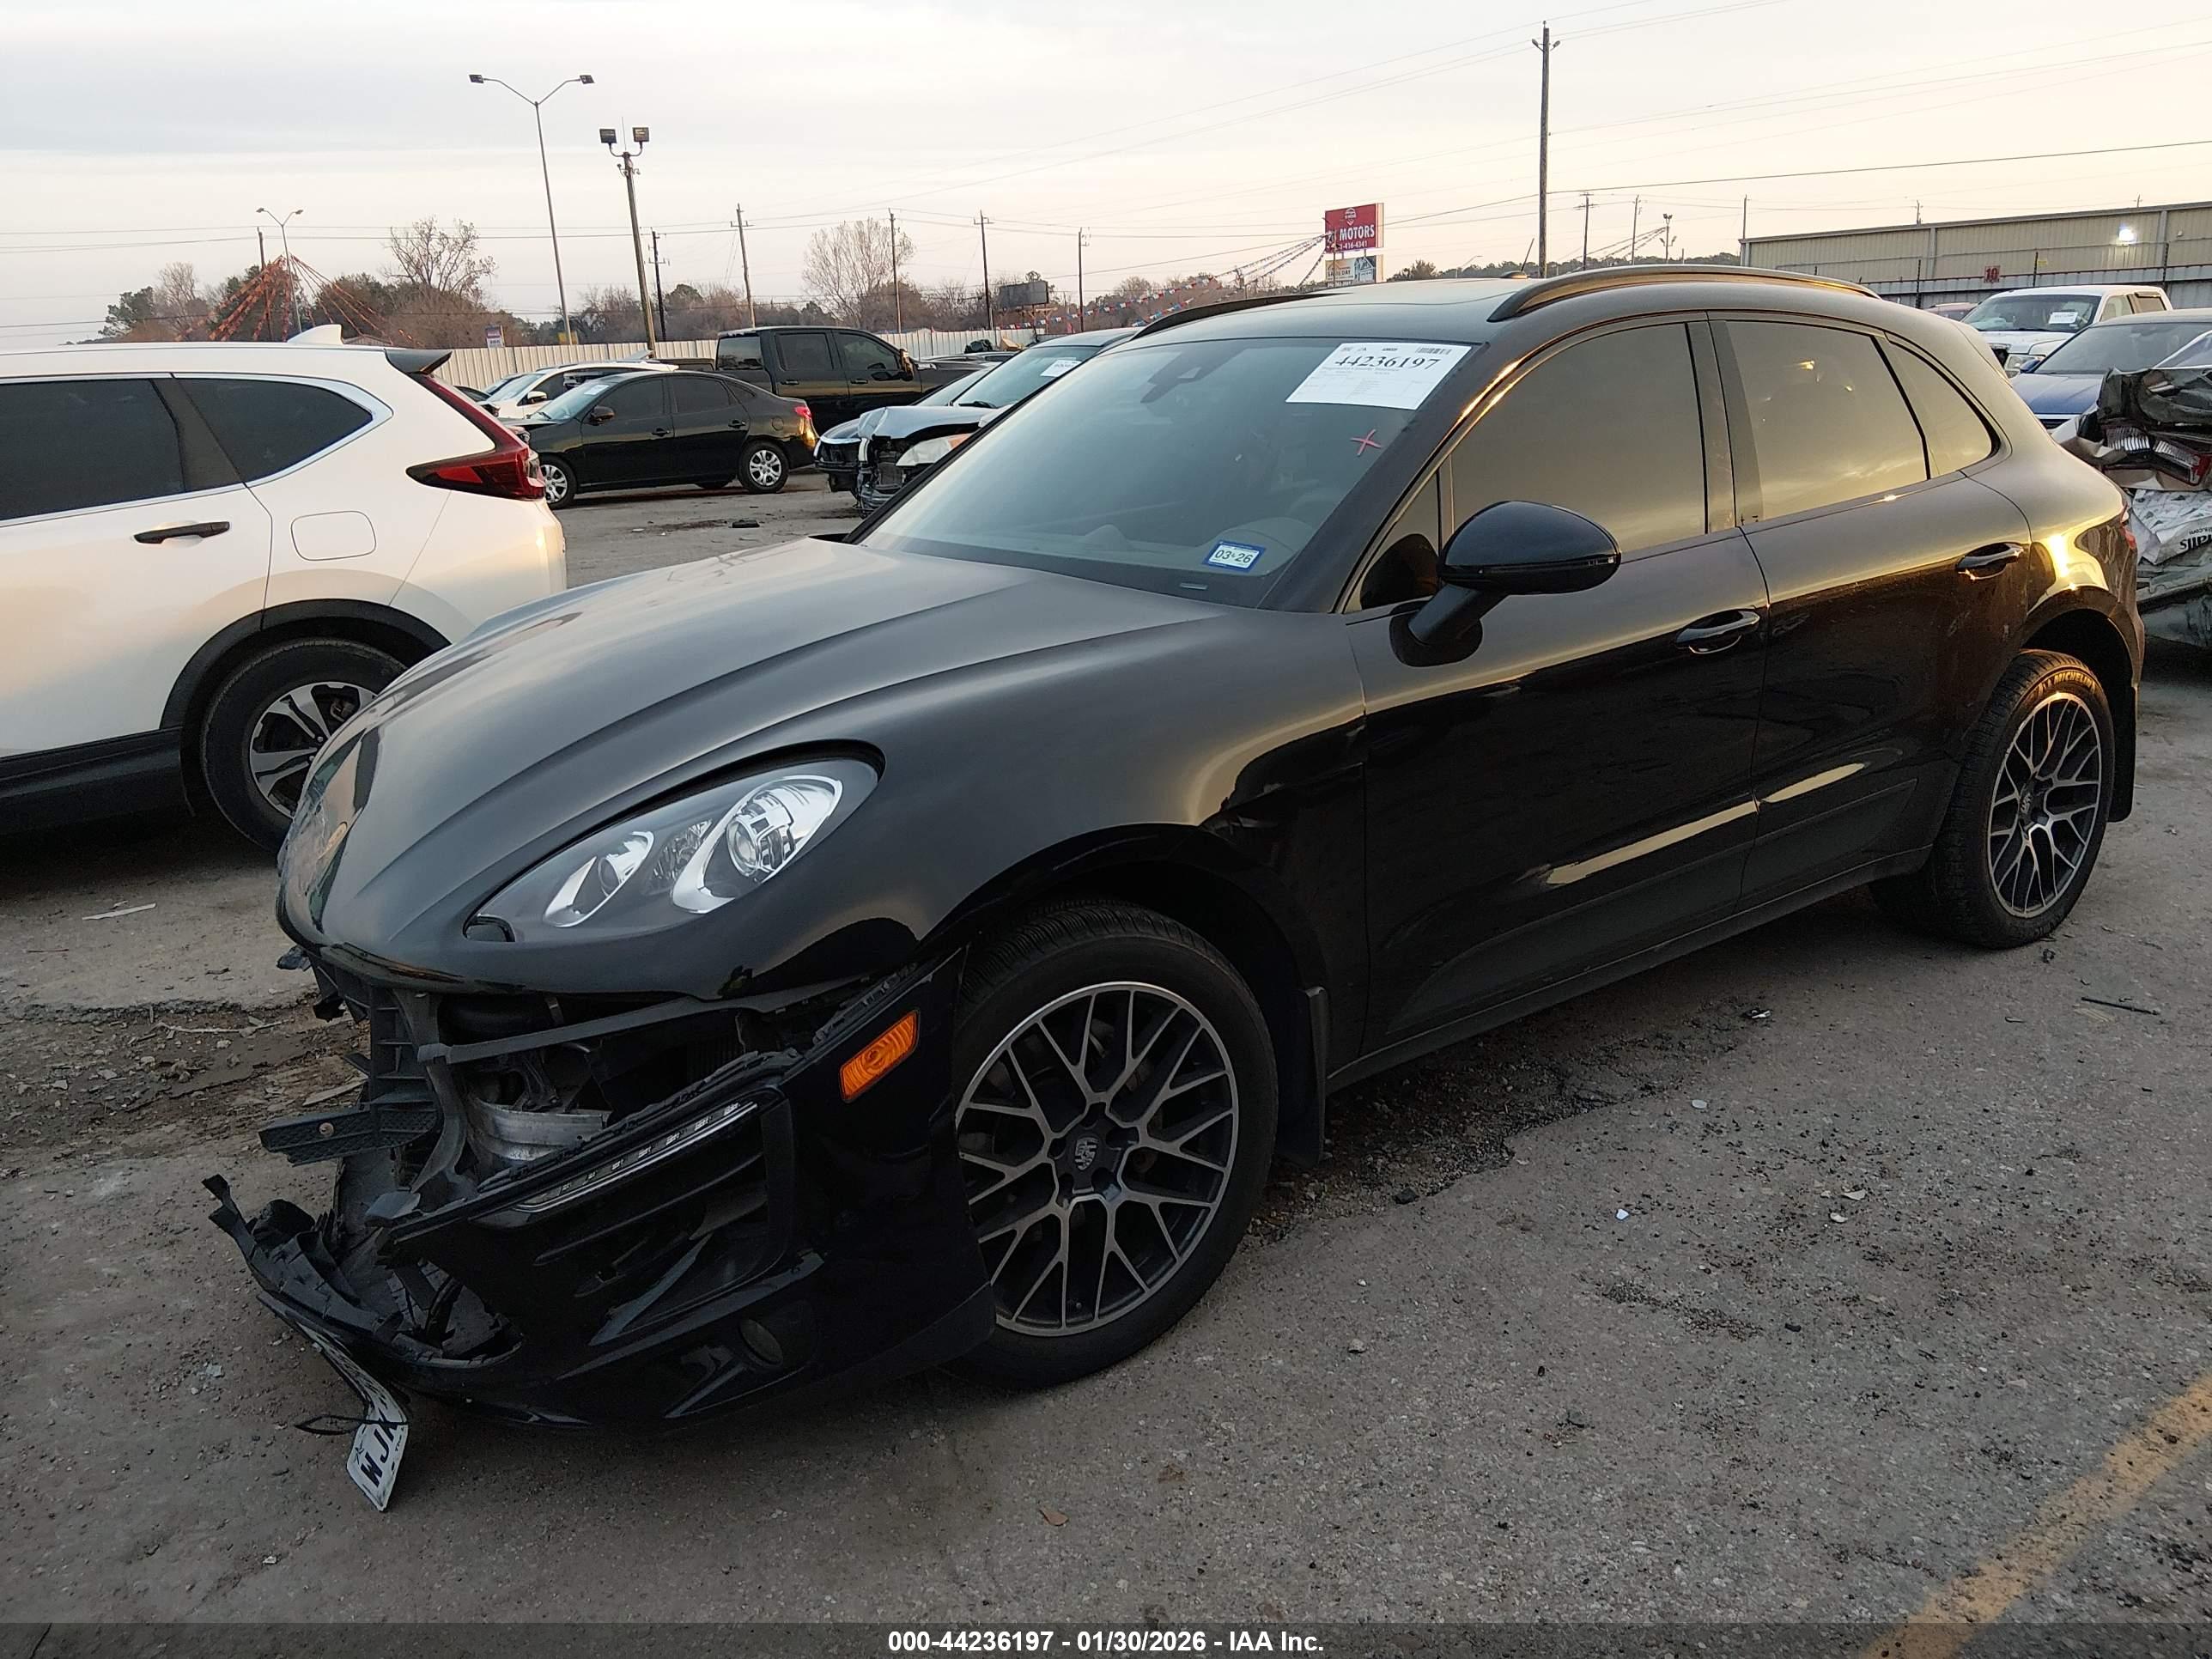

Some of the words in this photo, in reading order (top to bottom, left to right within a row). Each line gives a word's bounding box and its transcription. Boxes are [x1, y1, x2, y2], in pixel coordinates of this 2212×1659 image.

[1340, 224, 1375, 241] MOTORS
[1985, 267, 1998, 280] 10
[1335, 356, 1441, 370] 44236197
